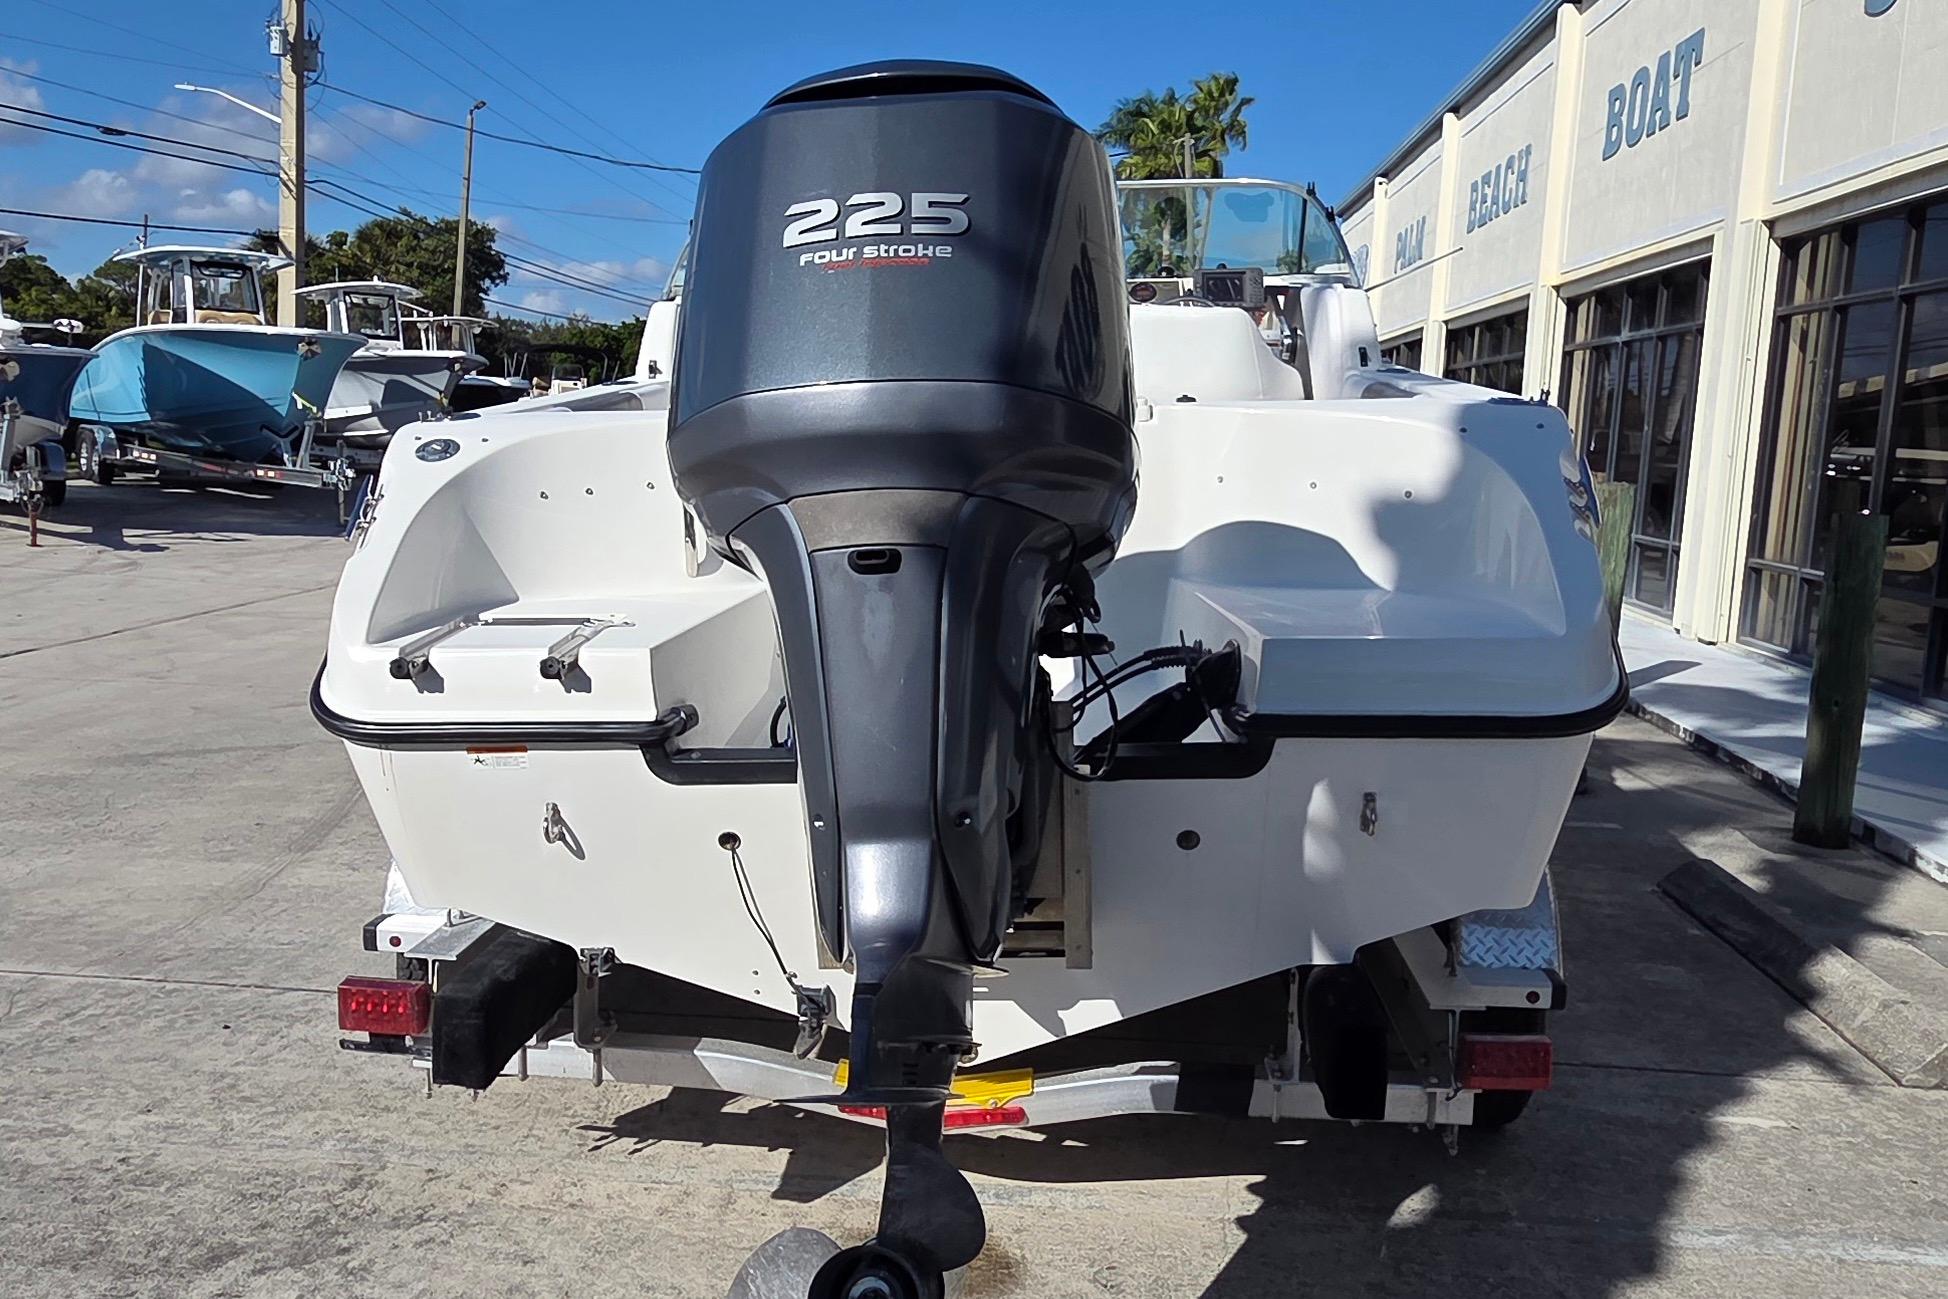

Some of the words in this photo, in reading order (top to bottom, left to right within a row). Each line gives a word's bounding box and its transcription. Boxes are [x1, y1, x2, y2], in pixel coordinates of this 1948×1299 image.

[1466, 143, 1532, 234] BEACH
[1602, 27, 1705, 161] BOAT
[783, 191, 972, 248] 225
